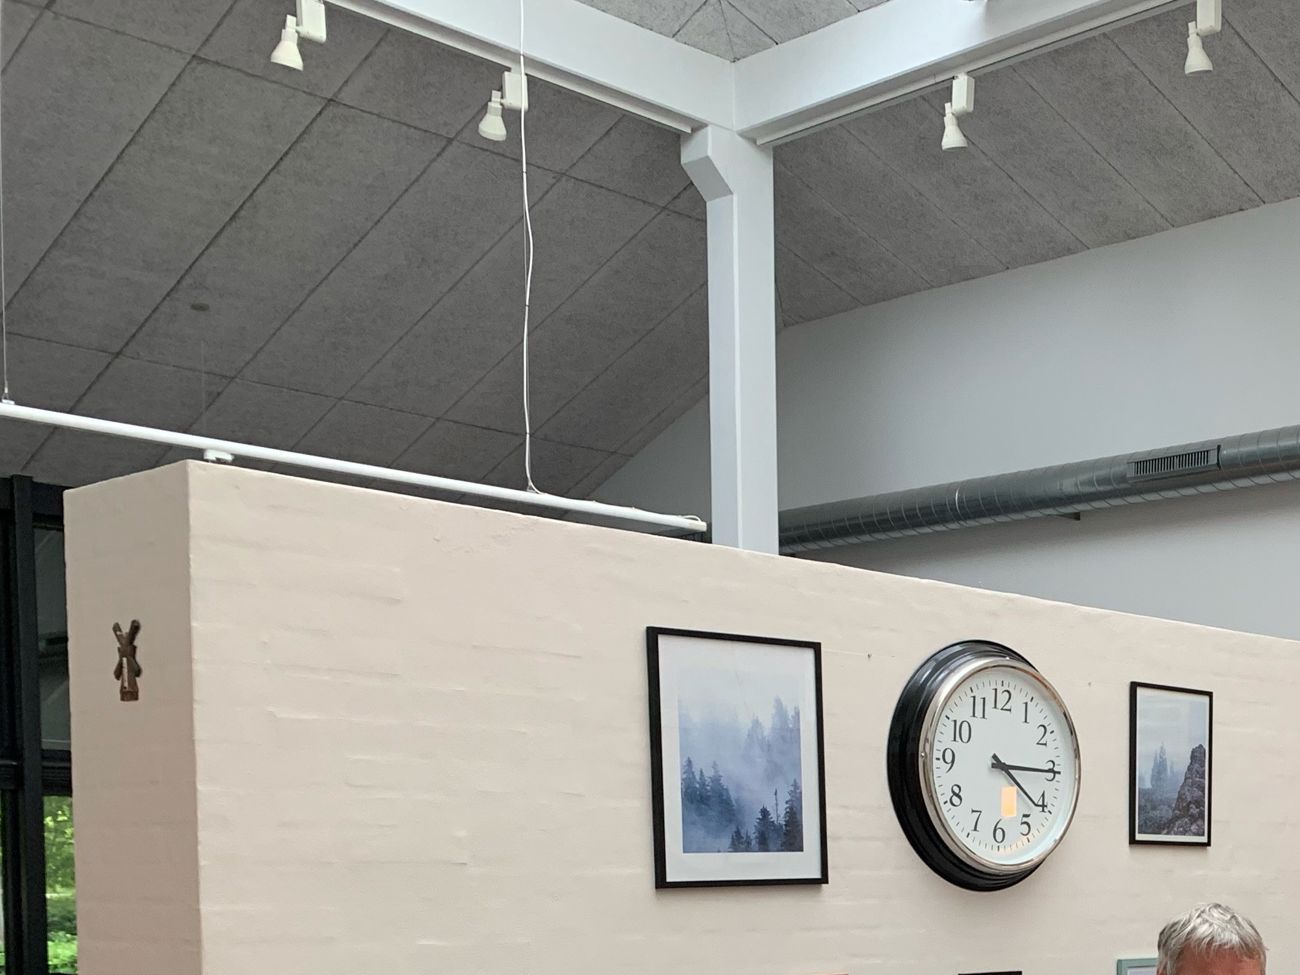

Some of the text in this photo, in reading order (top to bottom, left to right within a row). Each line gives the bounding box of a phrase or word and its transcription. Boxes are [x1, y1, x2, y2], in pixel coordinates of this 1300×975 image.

[970, 695, 987, 719] 11
[992, 687, 1012, 711] 12
[1022, 701, 1030, 723] 1
[951, 719, 972, 743] 10
[1036, 724, 1048, 746] 2
[942, 747, 956, 773] 9
[1044, 760, 1057, 782] 3
[950, 784, 963, 807] 8
[1034, 790, 1048, 813] 4
[971, 809, 983, 832] 7
[992, 818, 1006, 843] 6
[1019, 813, 1032, 836] 5
